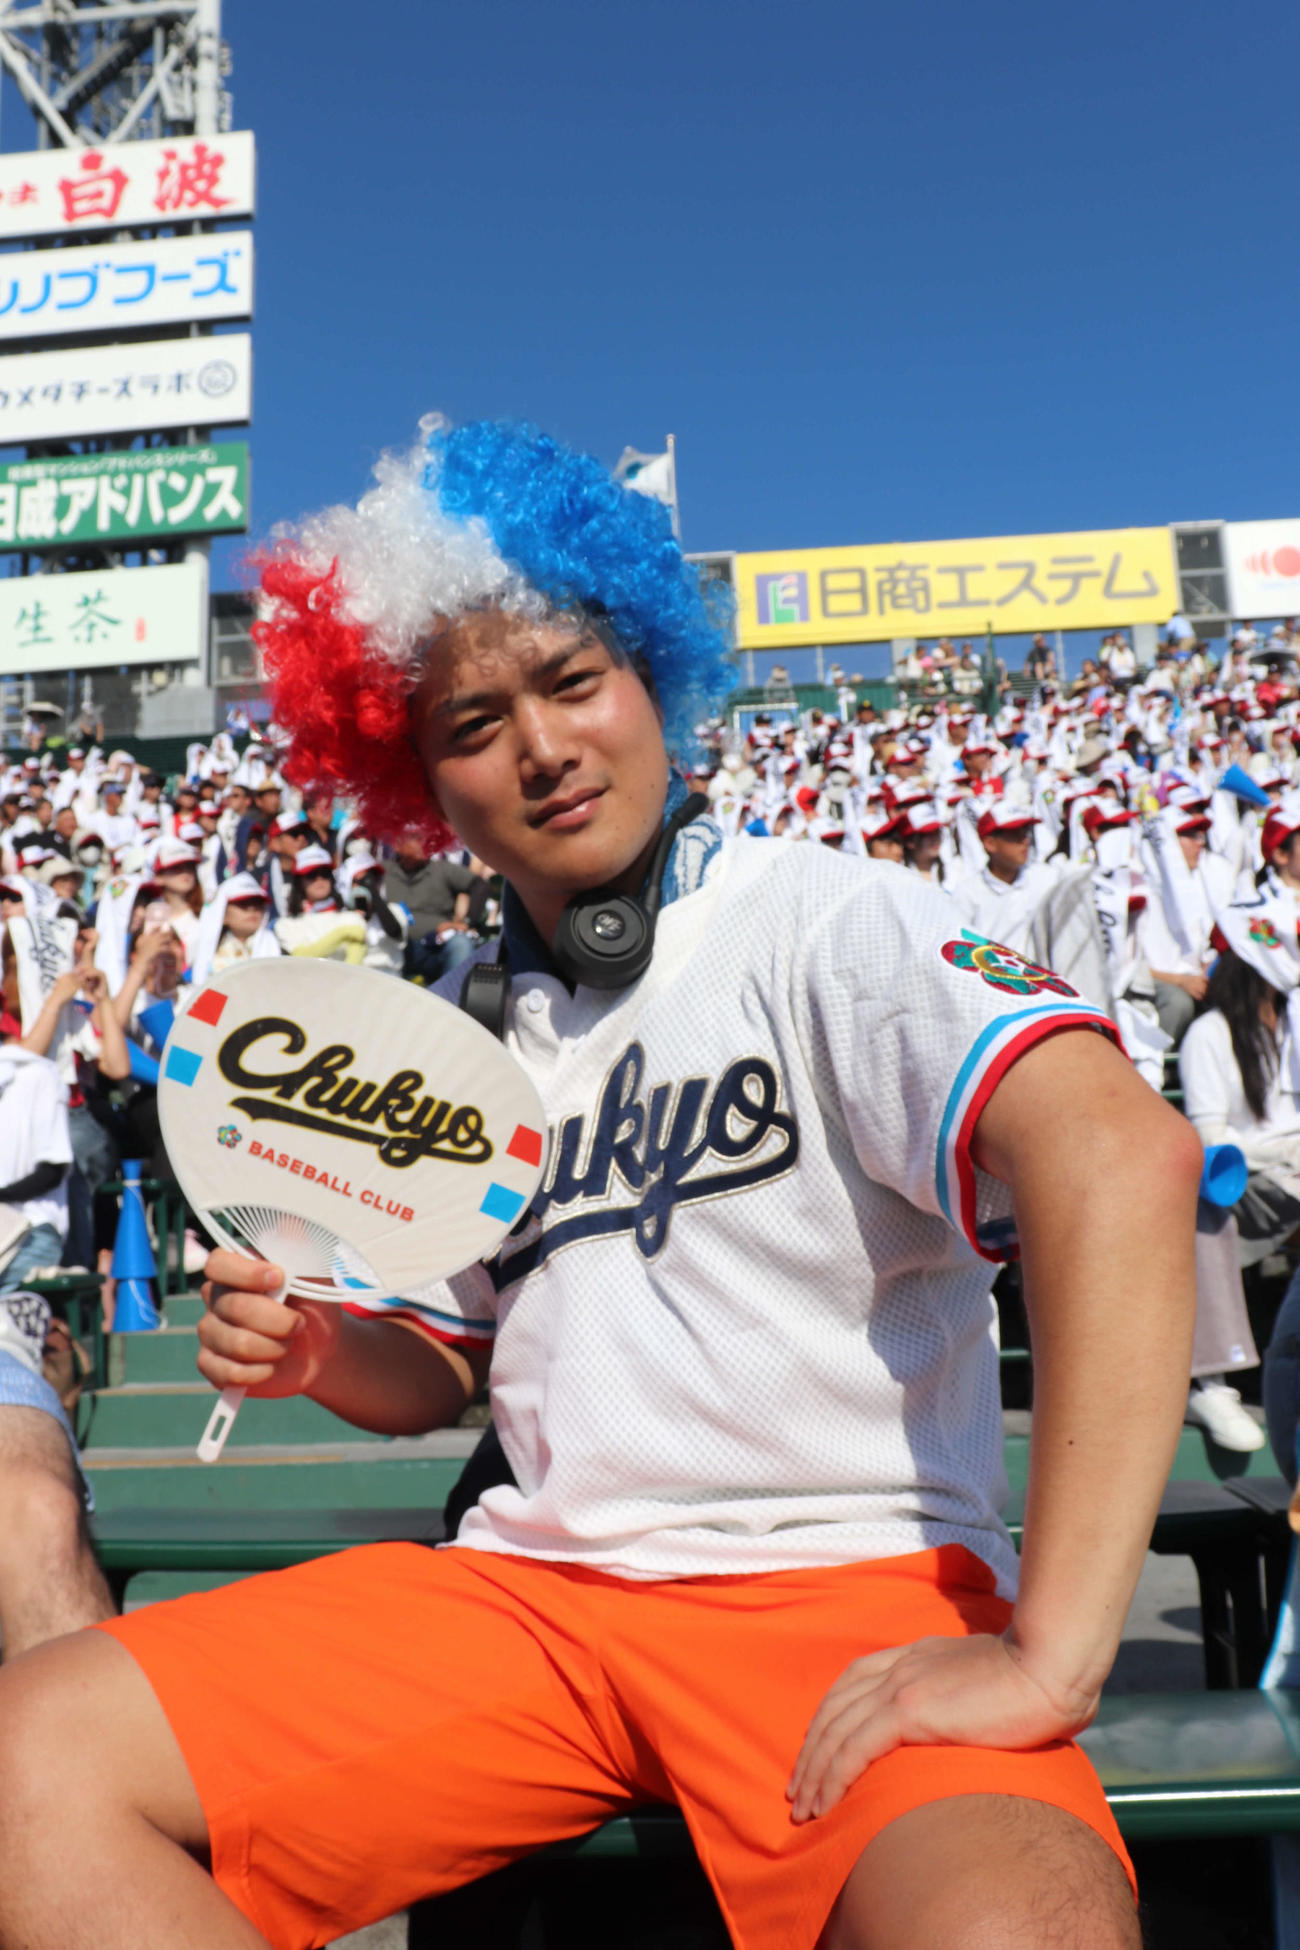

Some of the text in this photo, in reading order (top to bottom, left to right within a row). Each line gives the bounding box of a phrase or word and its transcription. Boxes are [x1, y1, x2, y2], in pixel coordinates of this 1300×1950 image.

[15, 588, 122, 647] 生茶
[820, 553, 1159, 618] 日商エステム
[217, 1016, 494, 1169] Chukyo
[249, 1140, 415, 1223] BASEBALL CLUB
